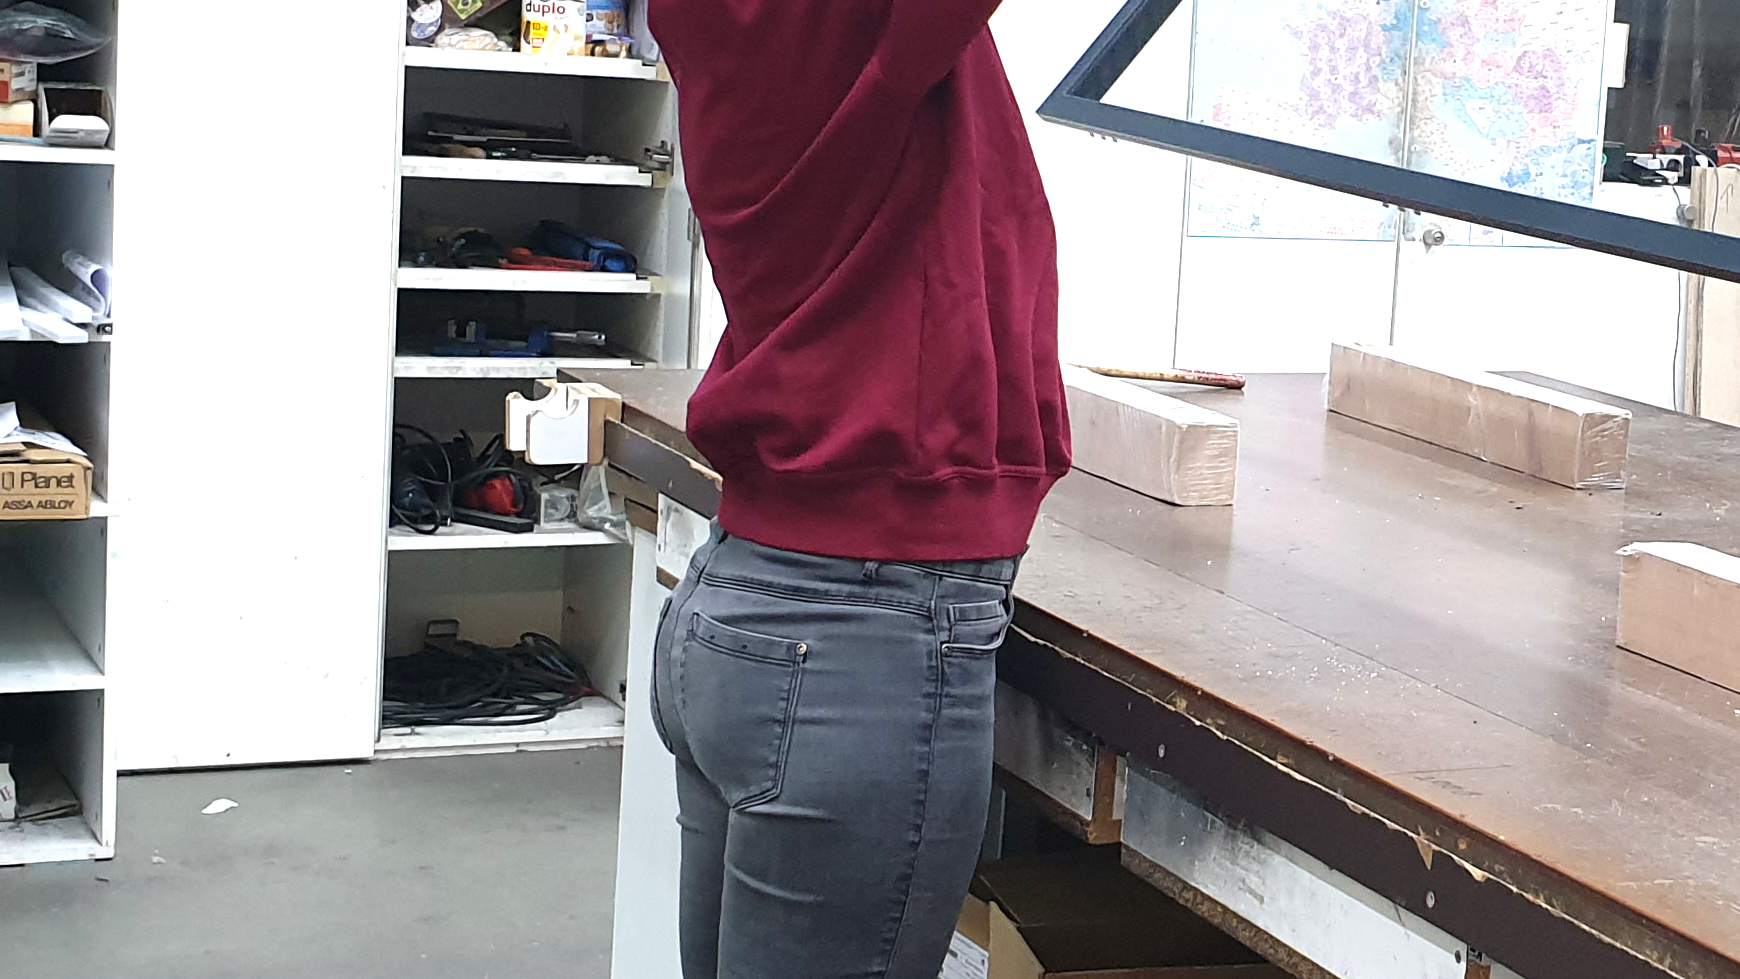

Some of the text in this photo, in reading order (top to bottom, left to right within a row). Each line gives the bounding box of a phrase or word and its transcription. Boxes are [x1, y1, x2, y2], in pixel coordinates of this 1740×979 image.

[525, 0, 566, 17] duplo
[20, 471, 76, 490] Planet
[2, 499, 75, 511] ASSA ABLOY
